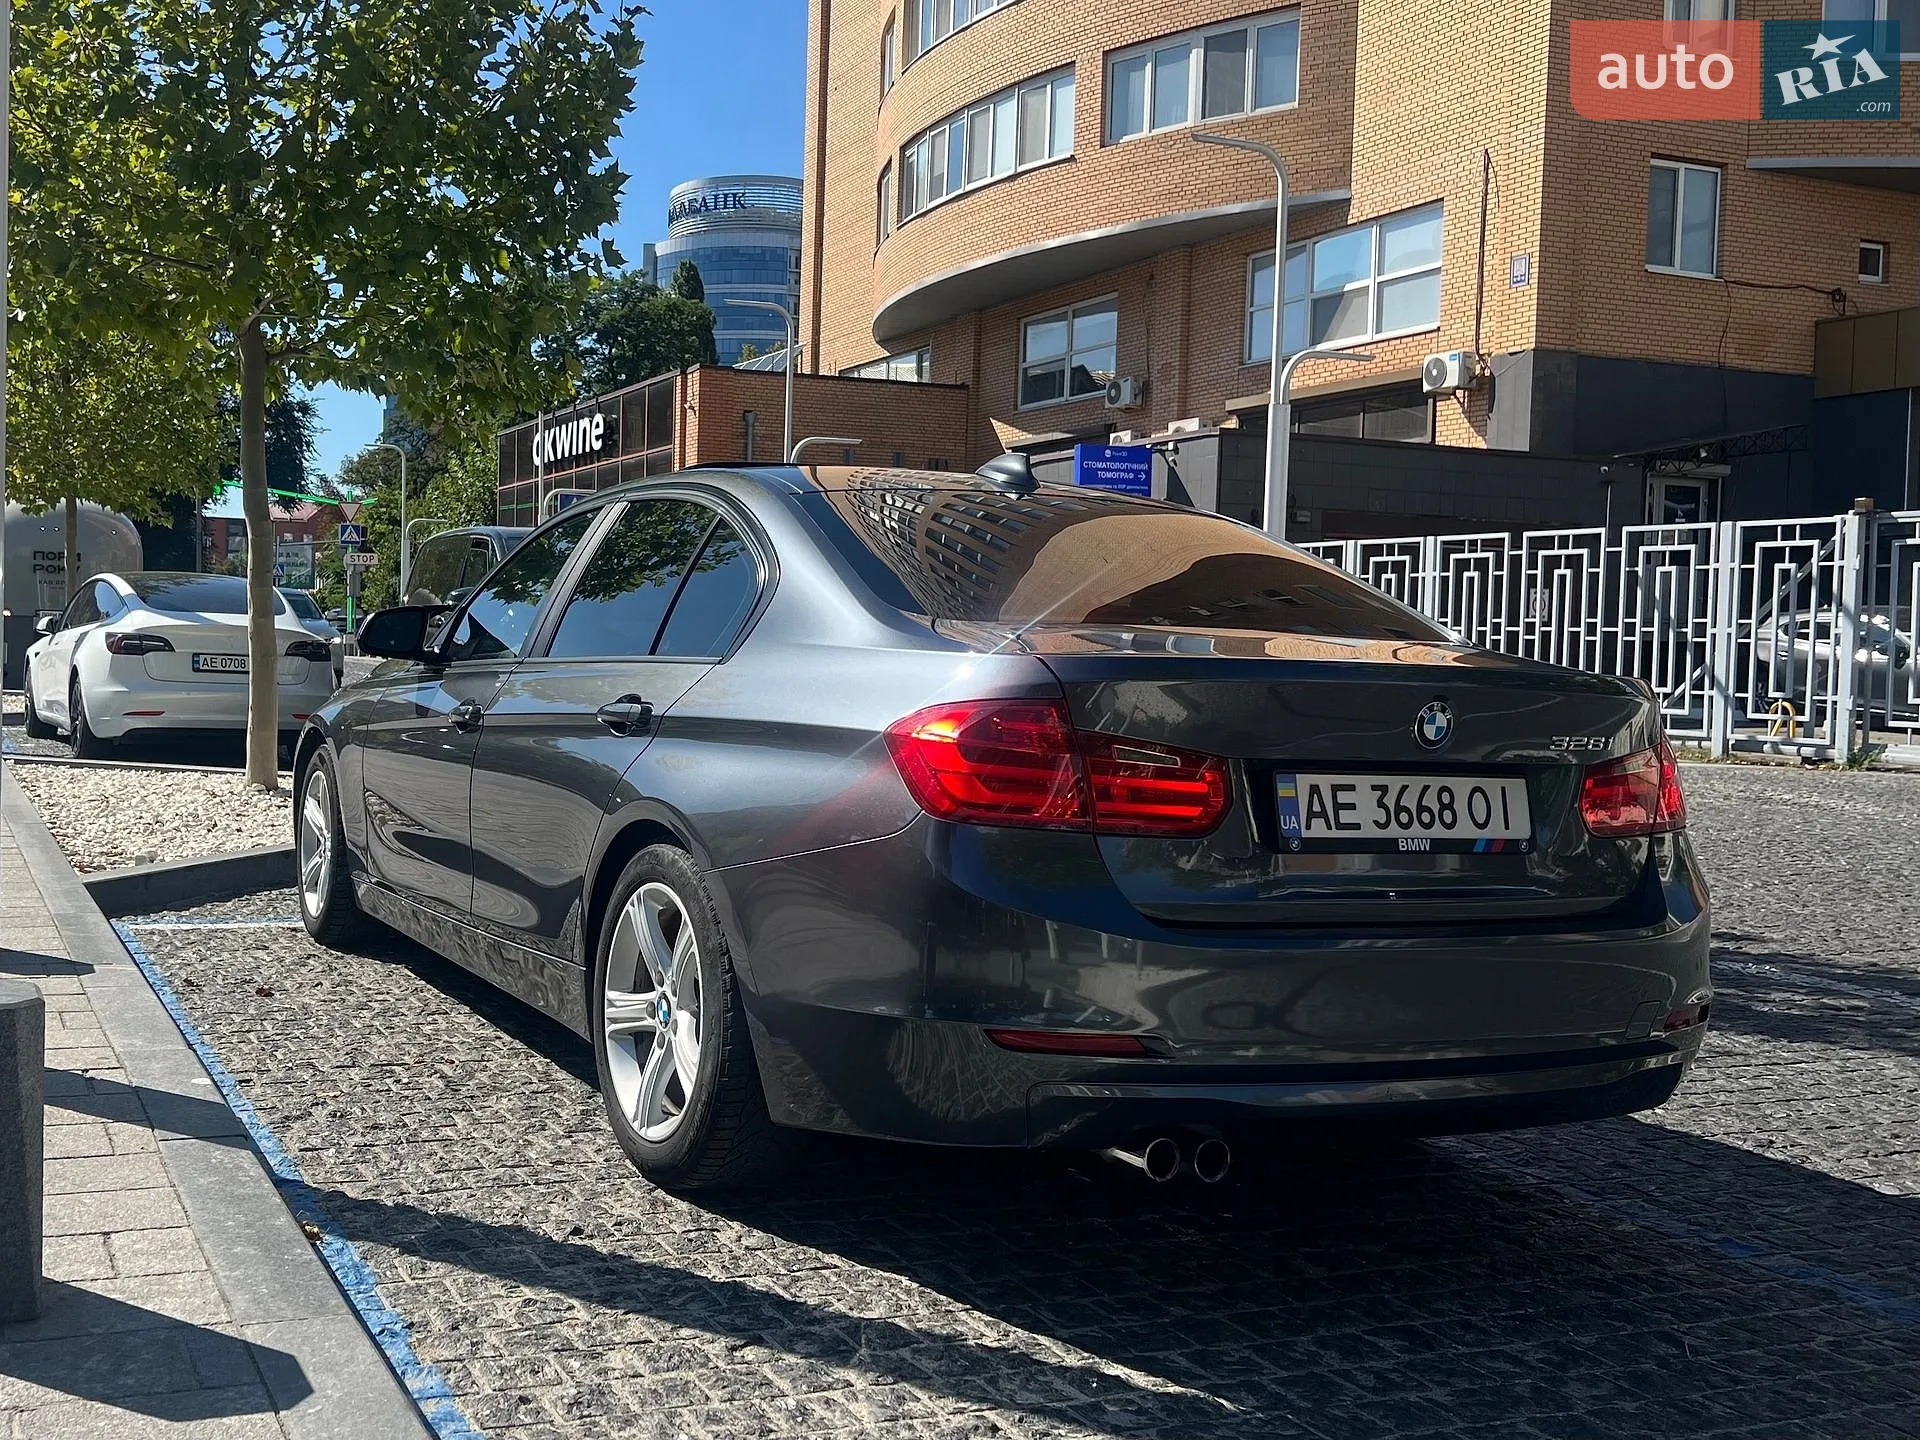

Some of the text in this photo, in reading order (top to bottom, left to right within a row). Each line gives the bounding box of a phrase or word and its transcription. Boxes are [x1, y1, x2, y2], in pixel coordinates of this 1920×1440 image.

[1097, 471, 1134, 479] ТОМОГРАФ
[350, 554, 375, 563] STOP
[201, 657, 246, 669] AE 0708
[1305, 783, 1362, 831] AE
[1370, 784, 1458, 831] 3668
[1280, 815, 1299, 830] UA
[1398, 838, 1431, 851] BMW
